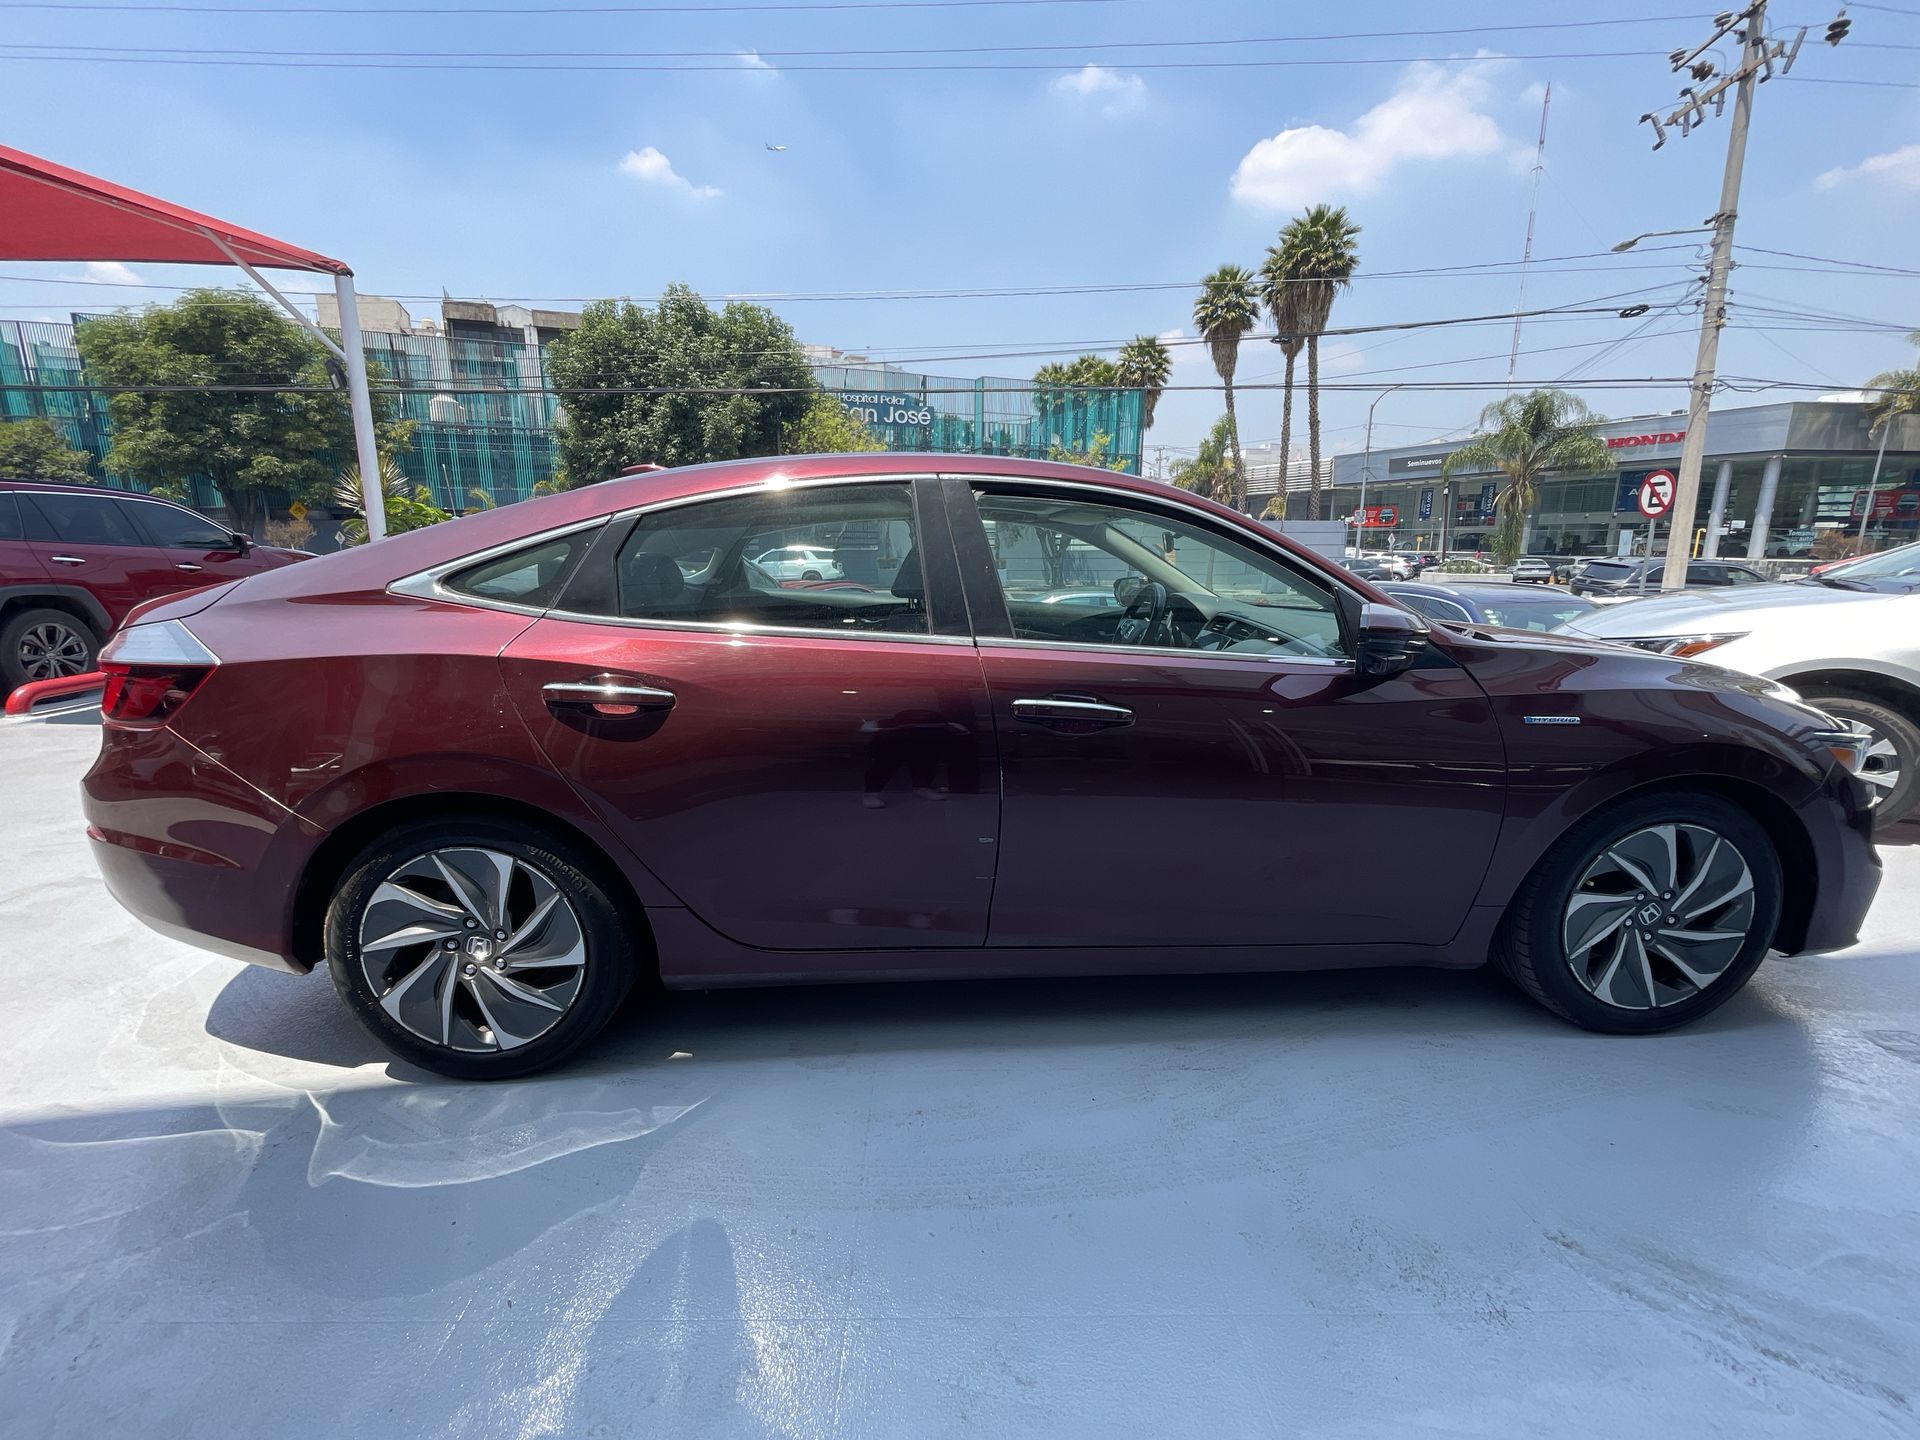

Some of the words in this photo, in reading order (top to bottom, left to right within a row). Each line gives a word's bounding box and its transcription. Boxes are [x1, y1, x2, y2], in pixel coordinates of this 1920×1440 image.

[838, 393, 877, 404] Hospital
[881, 395, 906, 406] Polar
[884, 407, 931, 425] José
[1607, 431, 1687, 449] HONDA
[1407, 458, 1442, 467] Seminuevos
